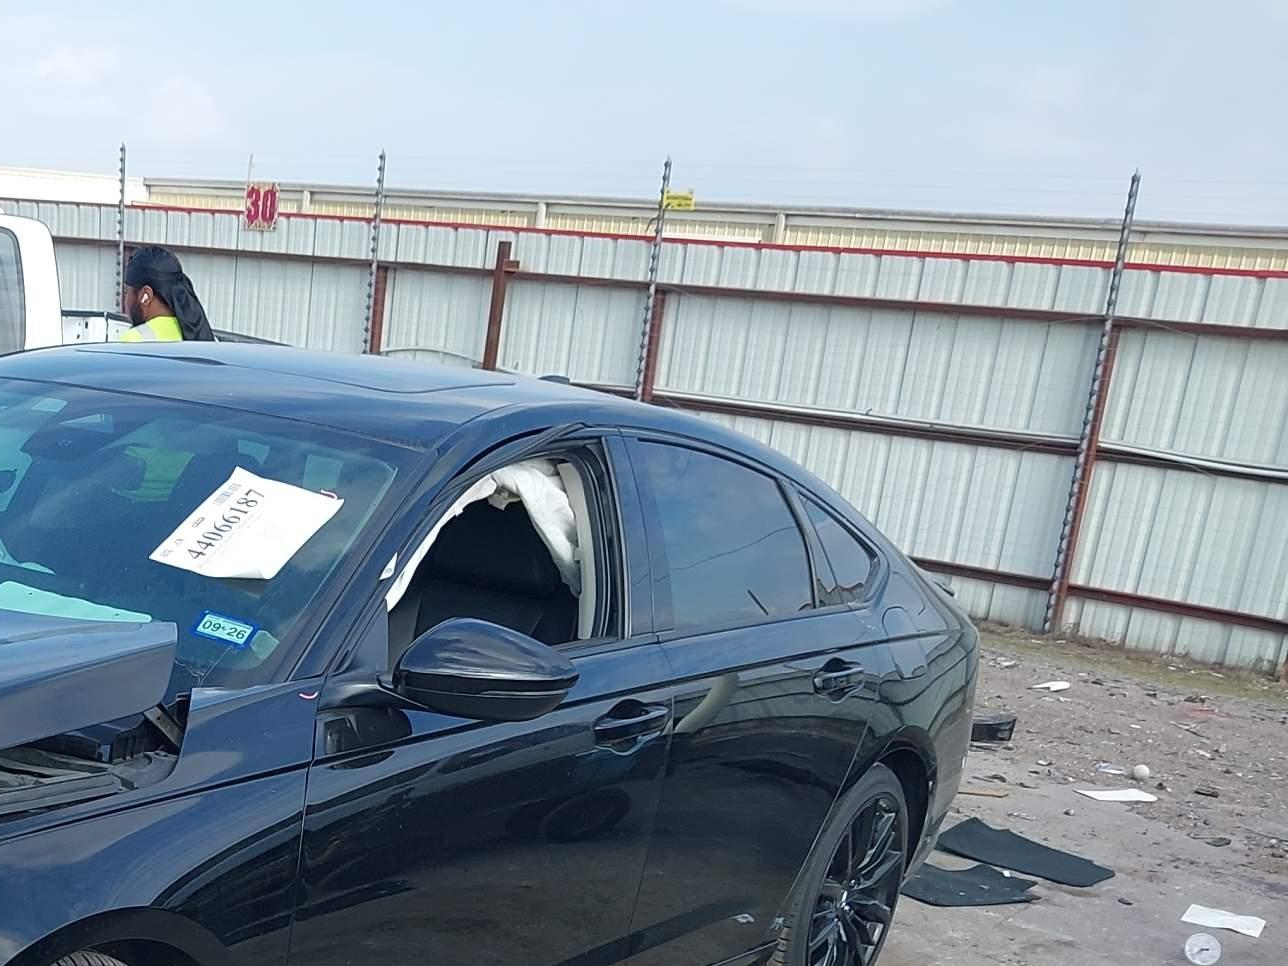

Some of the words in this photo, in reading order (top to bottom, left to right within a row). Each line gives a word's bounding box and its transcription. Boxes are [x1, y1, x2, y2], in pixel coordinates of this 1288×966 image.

[247, 189, 277, 224] 30
[187, 488, 265, 560] 44066187
[226, 627, 247, 640] 26
